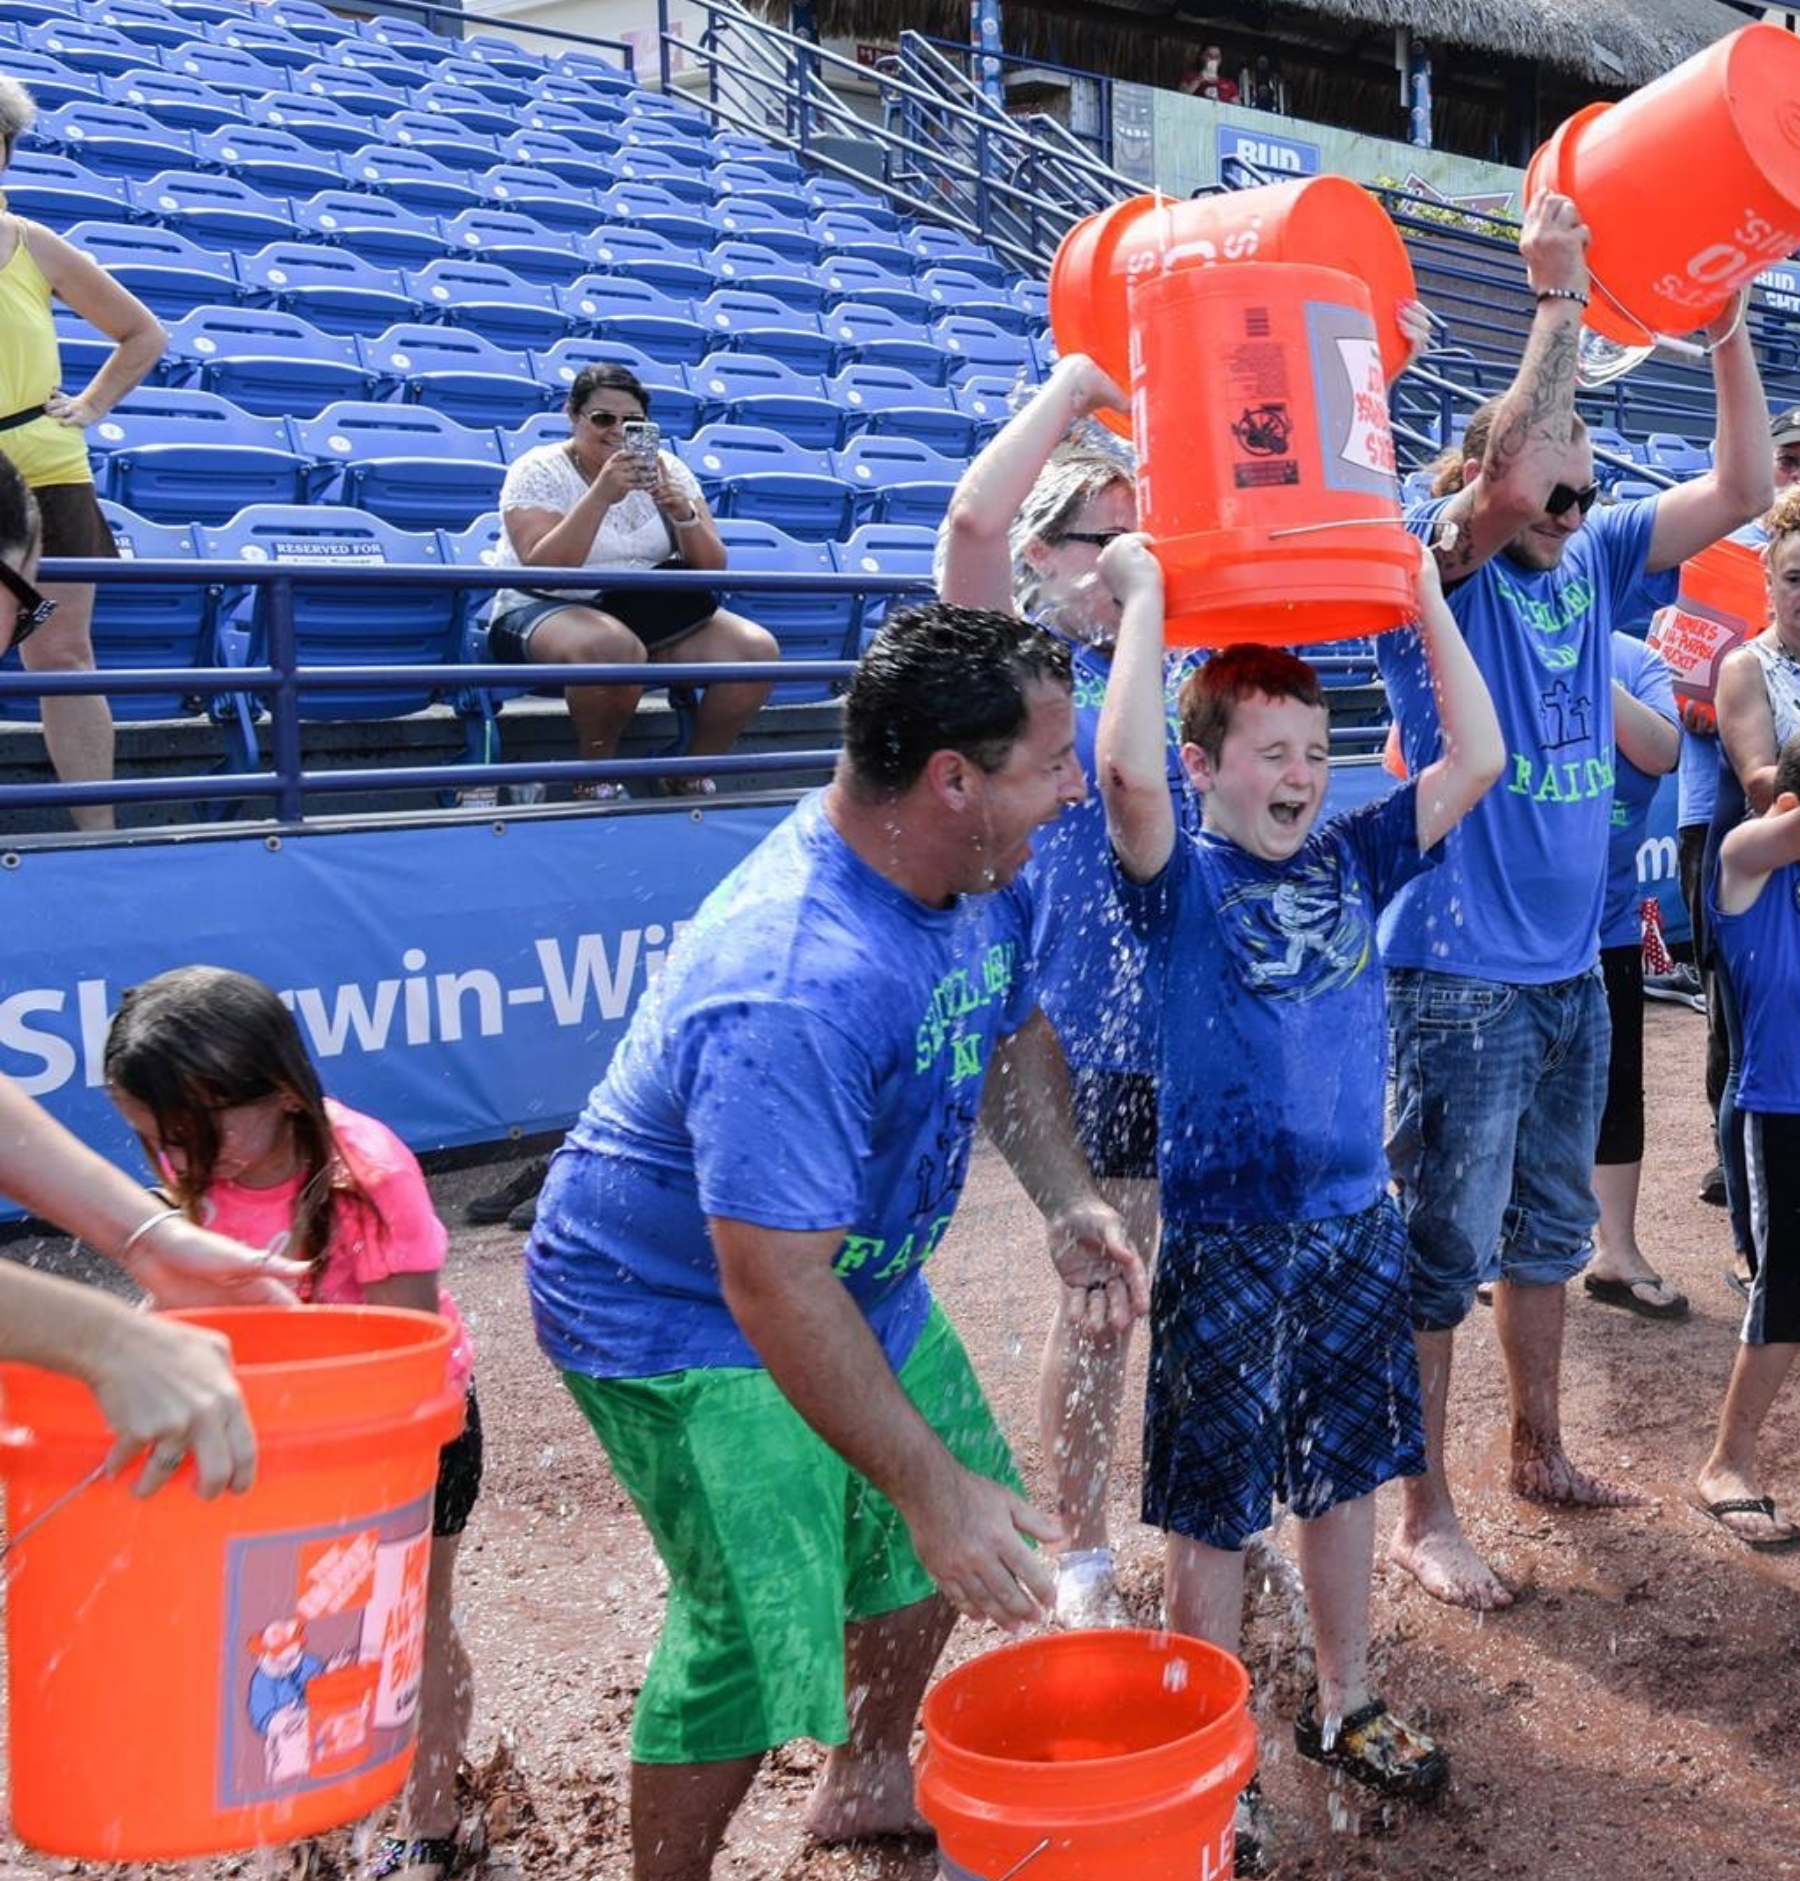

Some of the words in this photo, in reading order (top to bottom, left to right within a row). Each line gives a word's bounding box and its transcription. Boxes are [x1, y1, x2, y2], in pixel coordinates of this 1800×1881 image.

[1237, 138, 1301, 172] BUD
[276, 542, 349, 554] RESERVED
[353, 543, 381, 554] FOR
